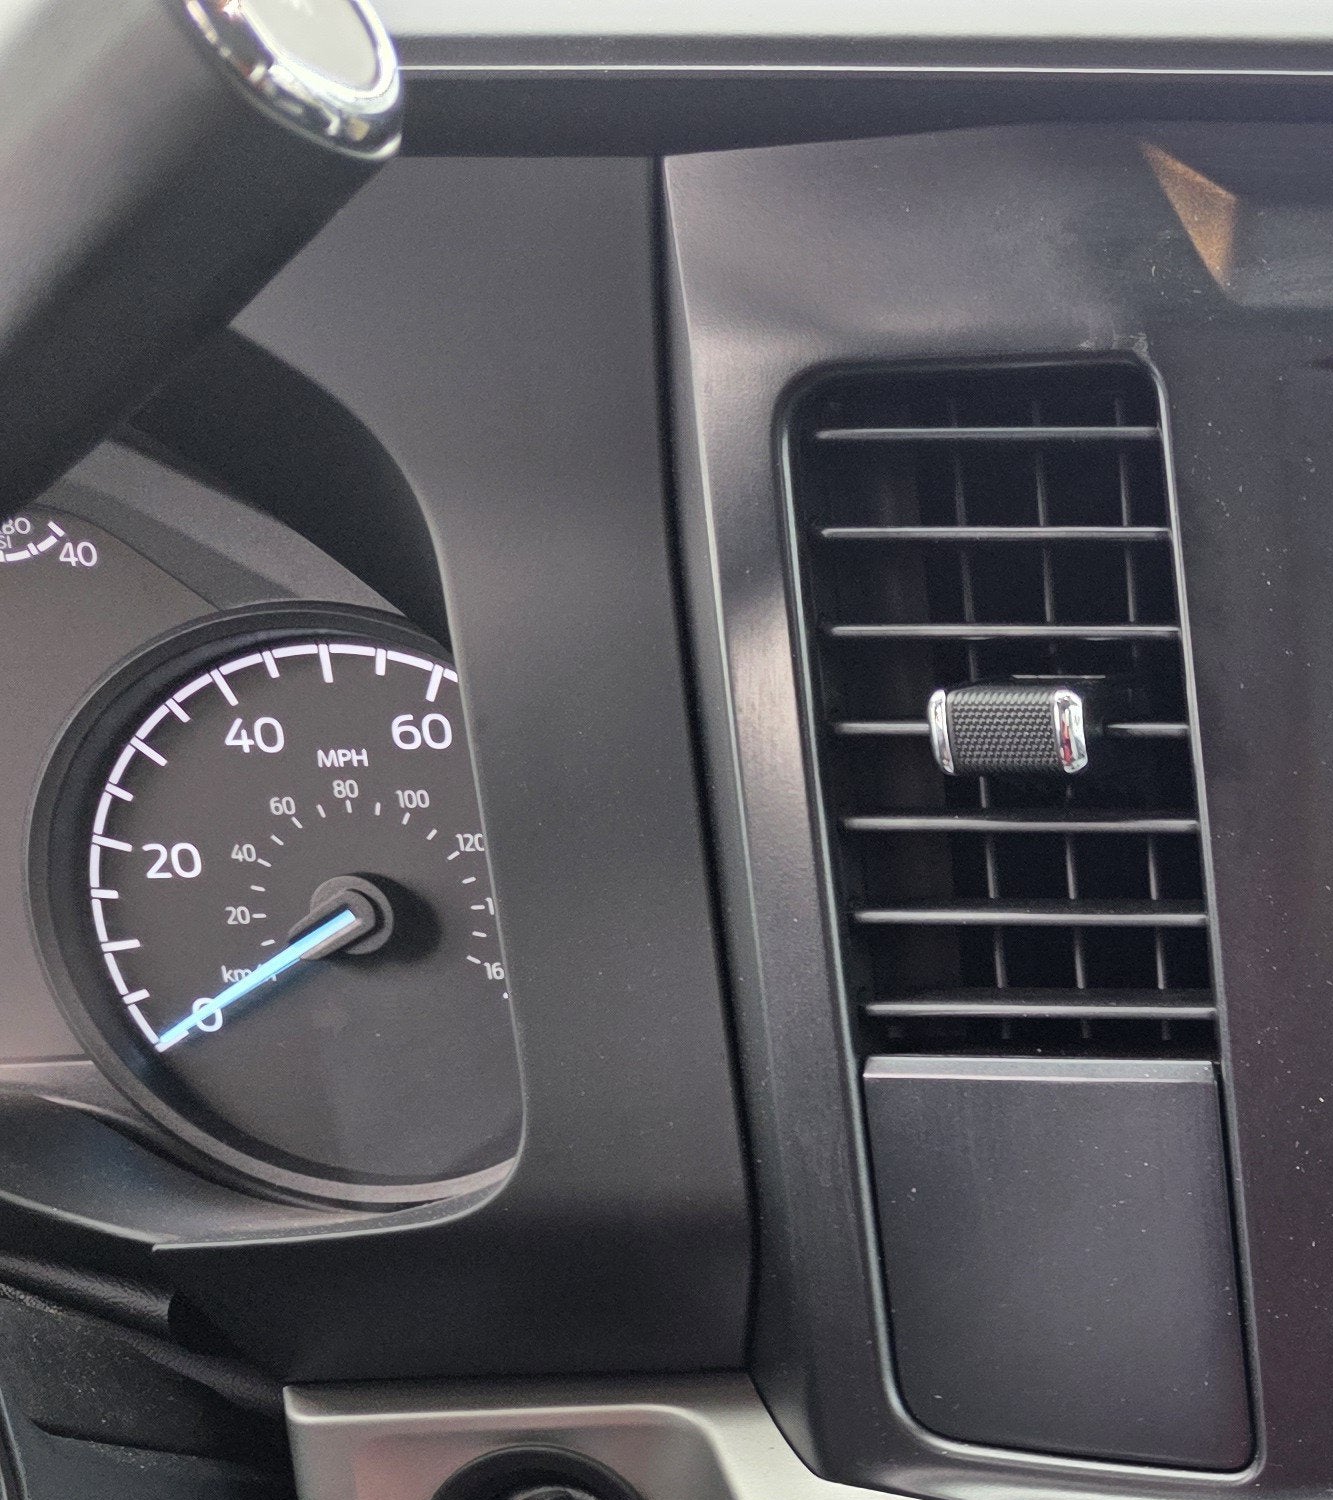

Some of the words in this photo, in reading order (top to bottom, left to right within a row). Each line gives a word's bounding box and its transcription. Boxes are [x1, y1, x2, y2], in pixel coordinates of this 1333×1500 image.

[59, 541, 98, 567] 40
[224, 716, 286, 754] 40
[391, 713, 454, 750] 60
[316, 748, 370, 769] MPH
[332, 779, 360, 800] 80
[394, 789, 431, 809] 100
[268, 796, 297, 816] 60
[141, 842, 203, 879] 20
[230, 843, 258, 863] 40
[224, 905, 251, 926] 20
